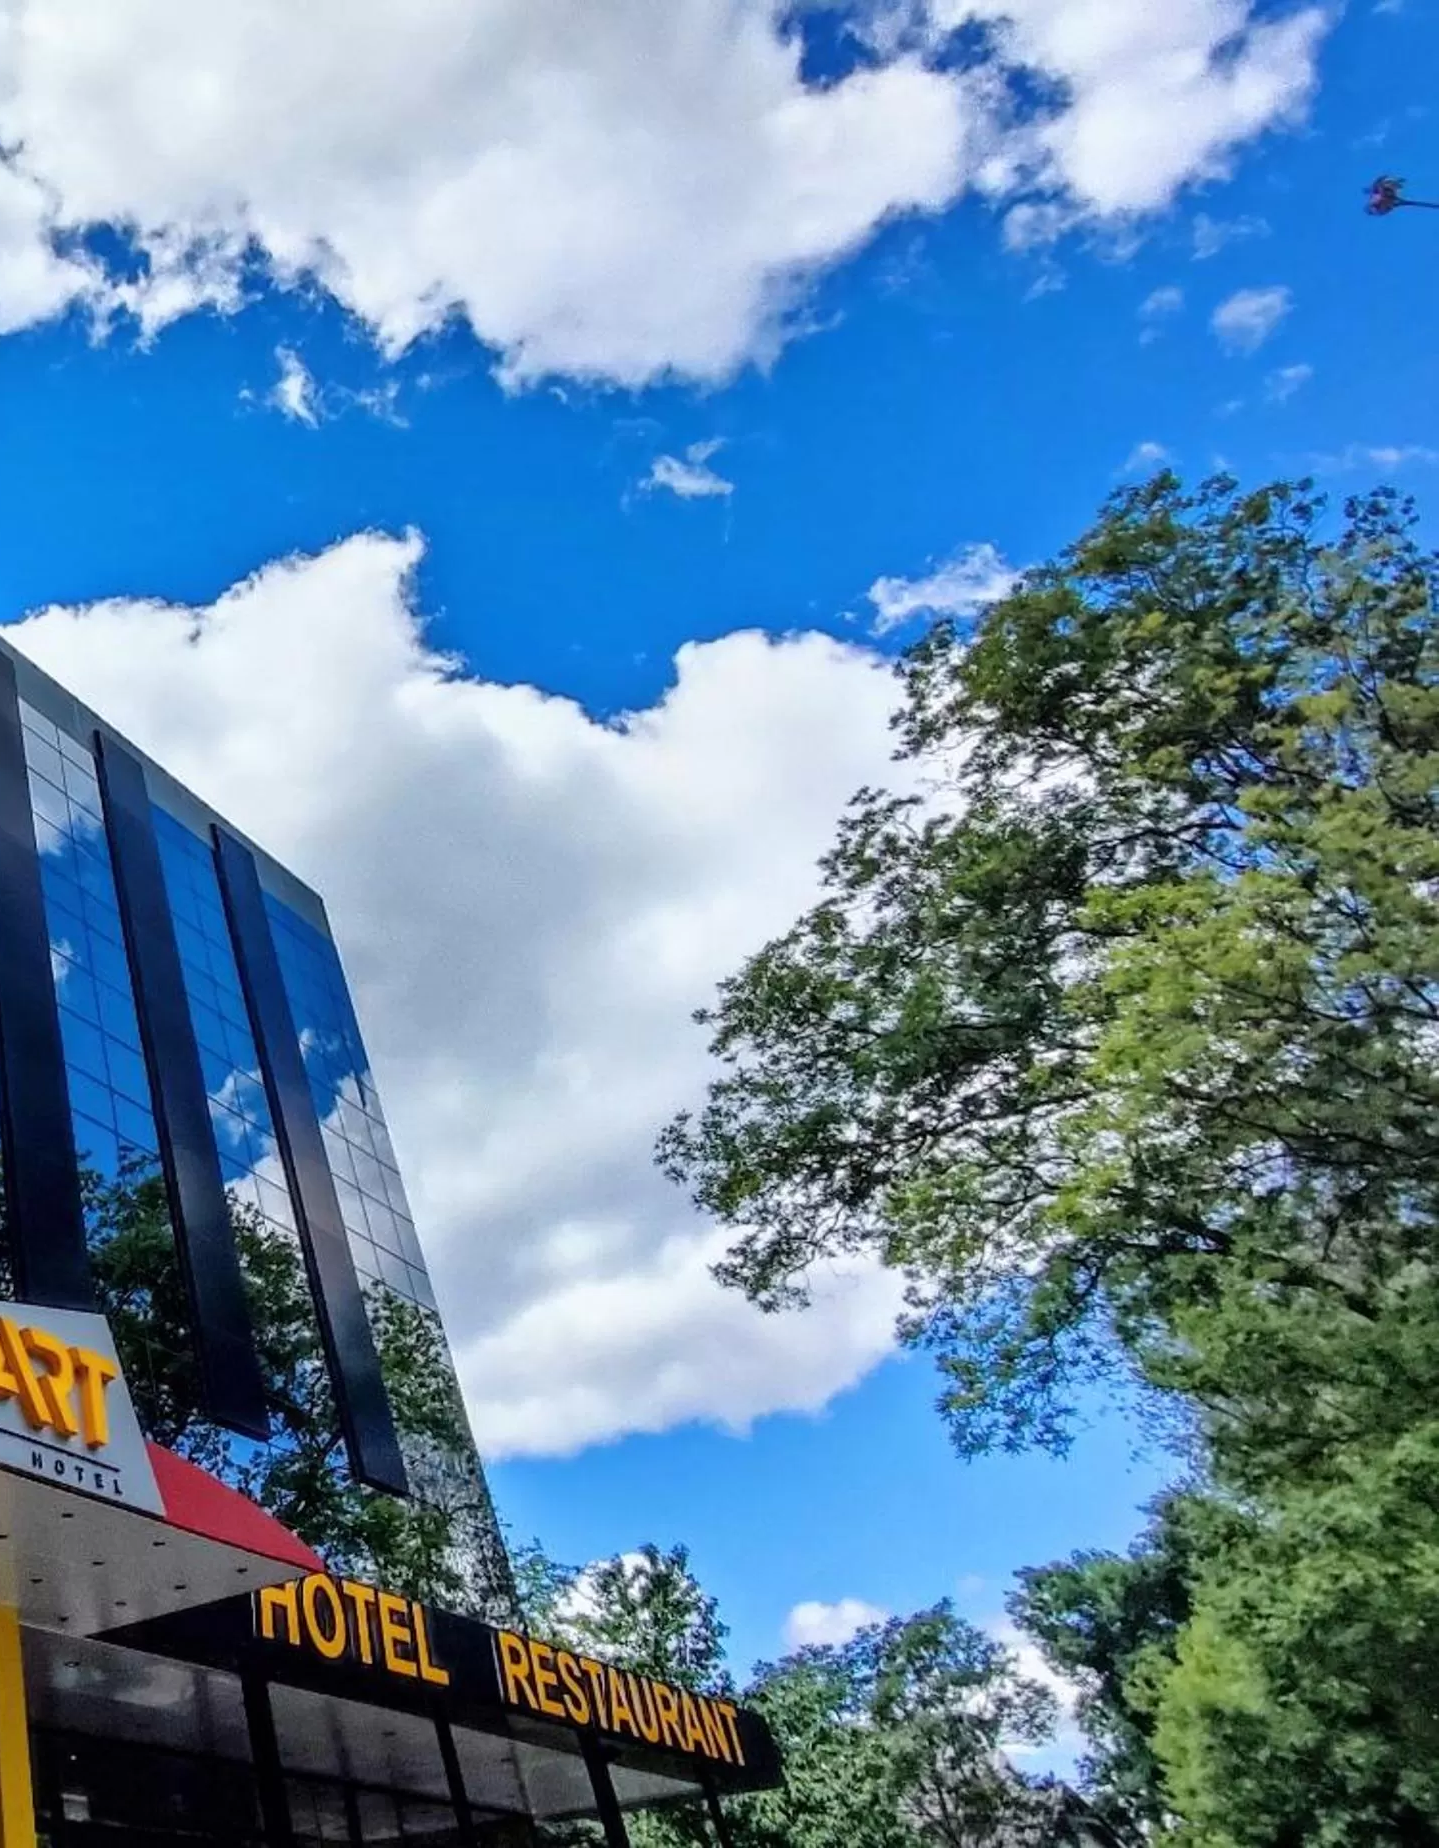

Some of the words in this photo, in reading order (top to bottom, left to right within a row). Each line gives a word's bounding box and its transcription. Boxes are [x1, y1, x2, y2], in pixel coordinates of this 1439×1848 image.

[31, 1452, 123, 1495] HOTEL
[260, 1573, 450, 1686] HOTEL
[498, 1631, 745, 1766] RESTAURANT
